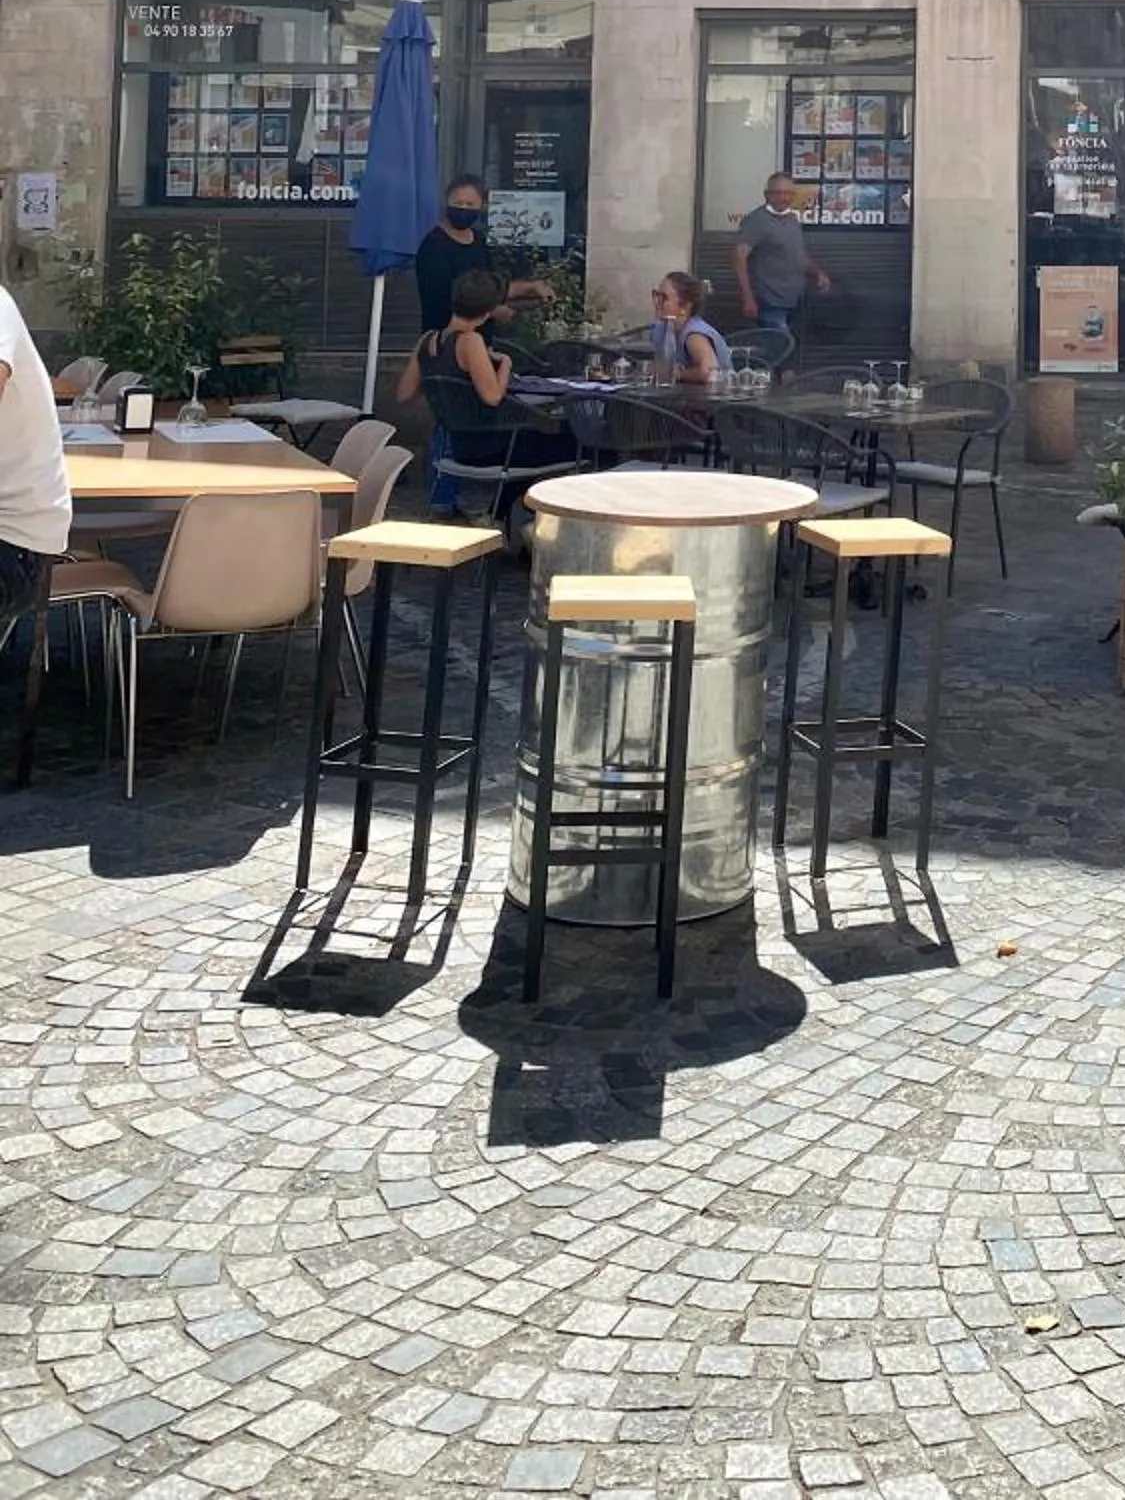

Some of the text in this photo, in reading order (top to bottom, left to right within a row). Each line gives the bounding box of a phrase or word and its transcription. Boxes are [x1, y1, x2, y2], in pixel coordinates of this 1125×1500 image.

[127, 5, 181, 20] VENTE
[144, 23, 160, 38] 04
[162, 23, 179, 38] 90
[237, 181, 354, 201] foncia.com
